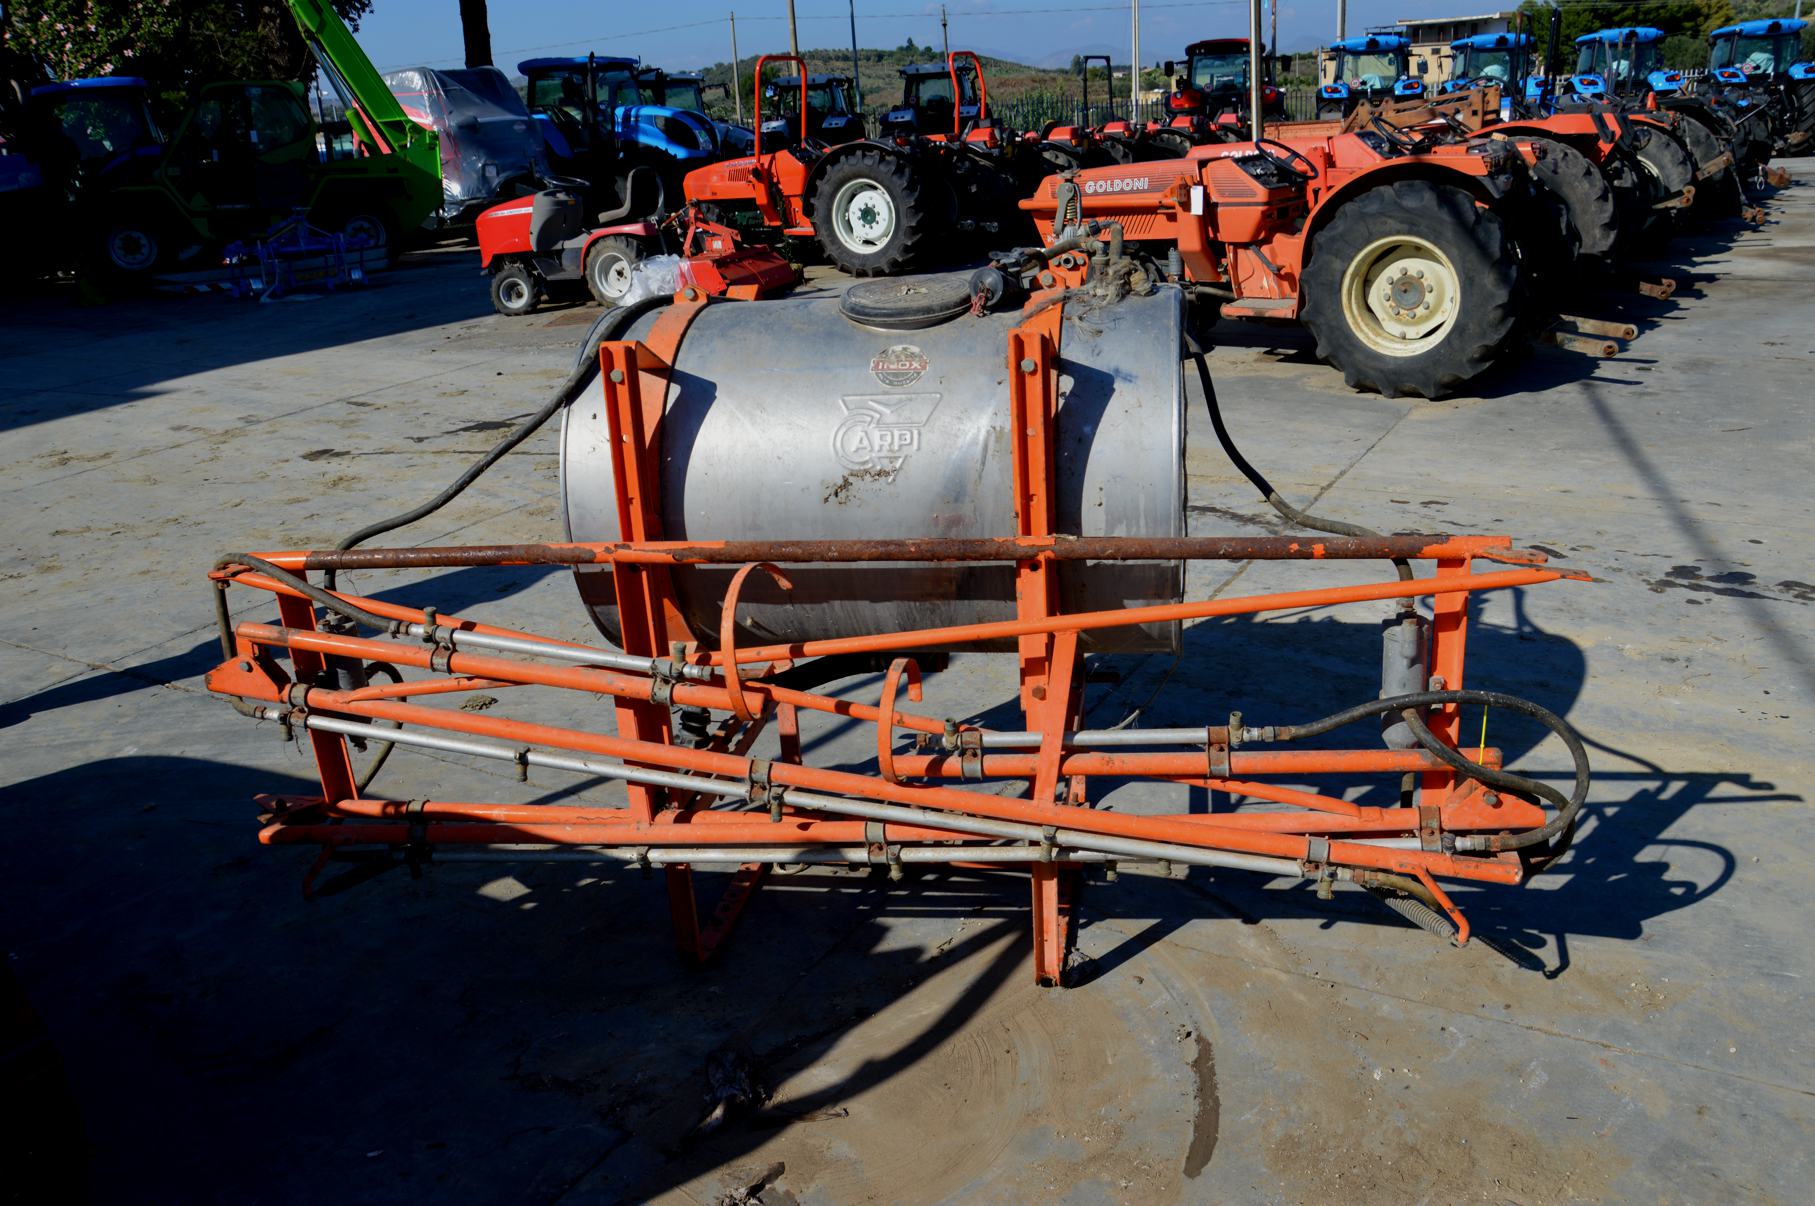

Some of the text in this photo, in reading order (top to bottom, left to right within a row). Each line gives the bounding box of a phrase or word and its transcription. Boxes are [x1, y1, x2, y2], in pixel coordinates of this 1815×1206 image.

[1084, 177, 1149, 194] GOLDONI
[878, 361, 922, 369] INOX
[834, 409, 921, 470] CARPI
